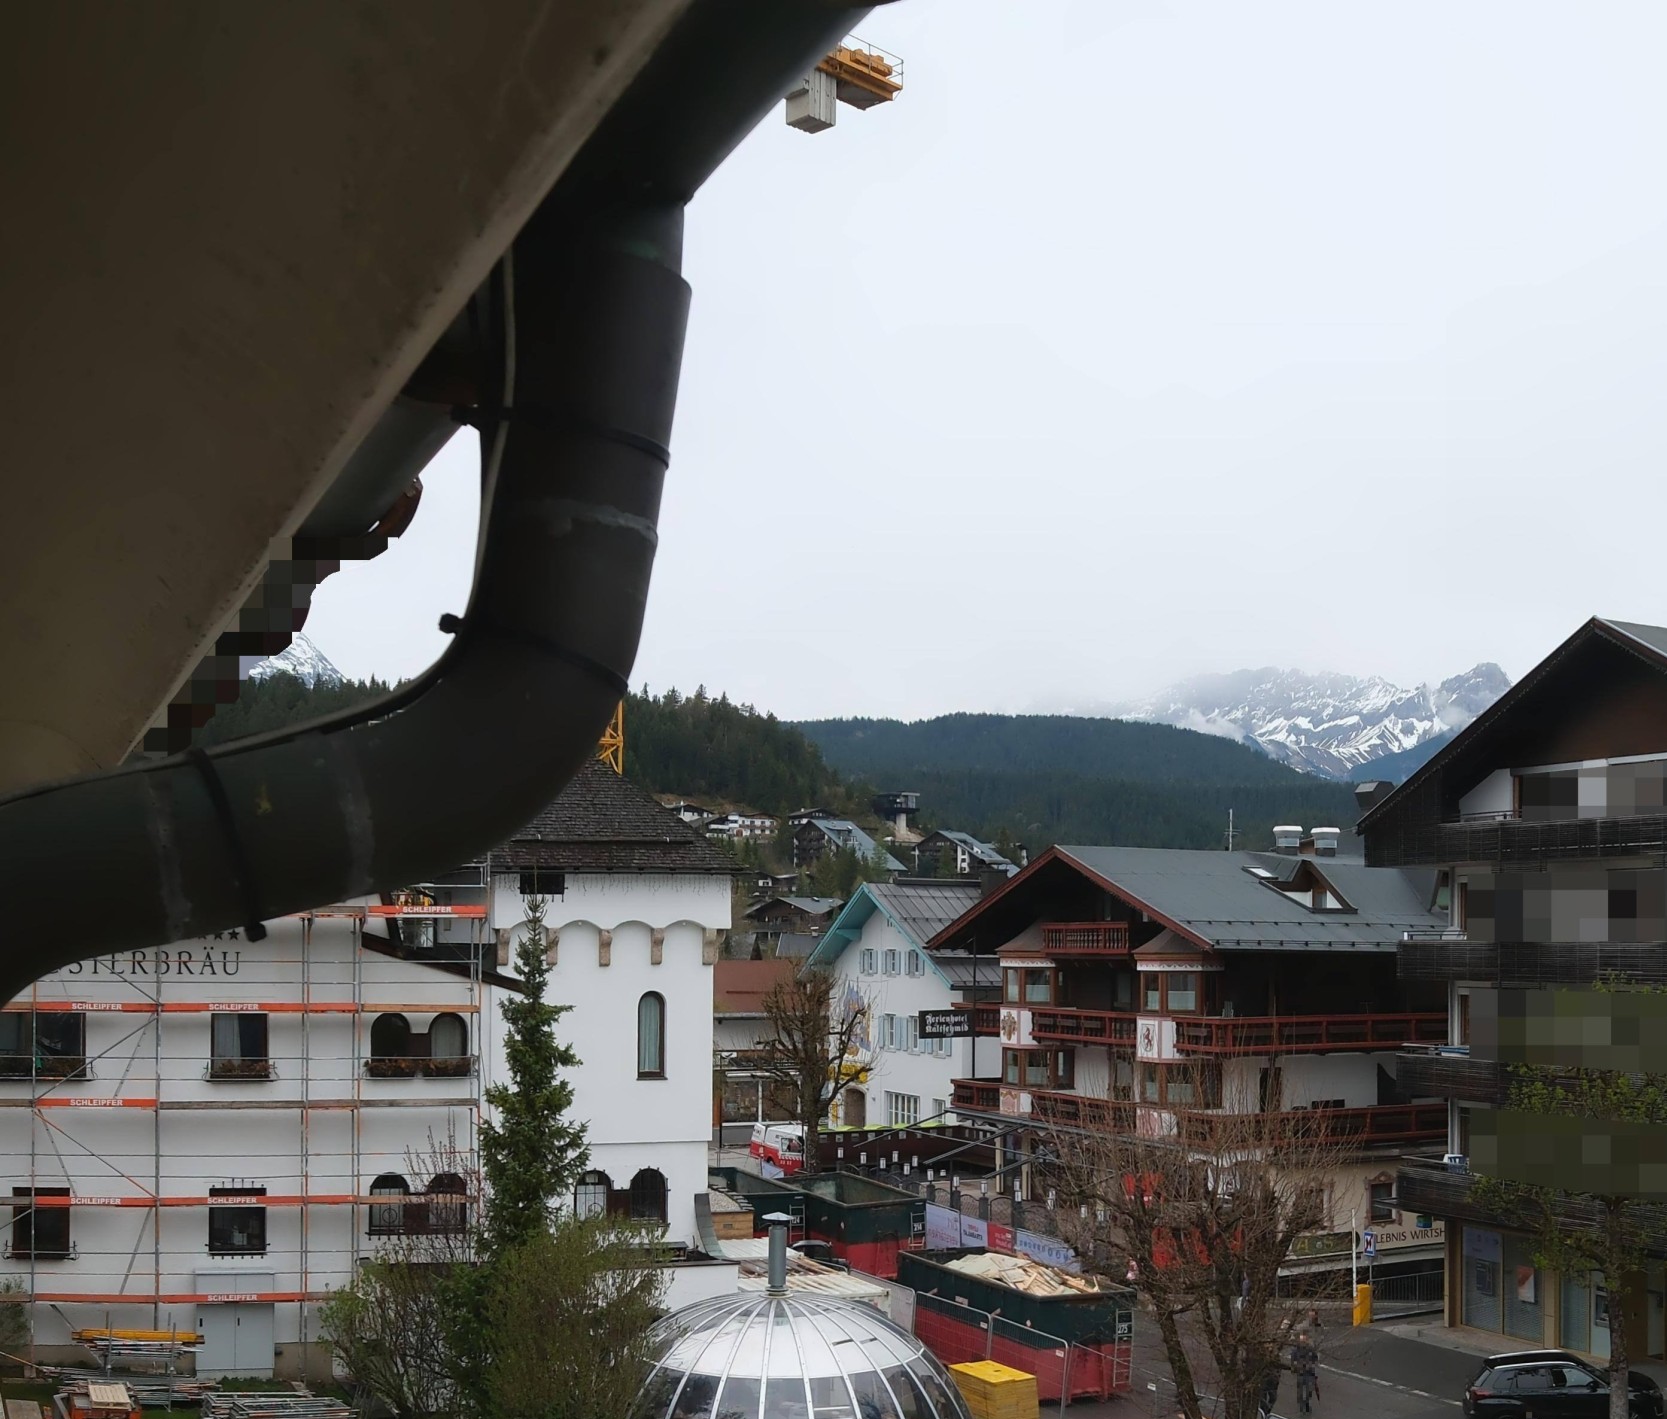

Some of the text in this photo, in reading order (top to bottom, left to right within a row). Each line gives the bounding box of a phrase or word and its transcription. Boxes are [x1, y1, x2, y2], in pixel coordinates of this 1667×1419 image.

[50, 946, 241, 975] STERBRÄU
[72, 1002, 122, 1010] SCHLEIPFER
[208, 1294, 258, 1302] SCHLEIPFER
